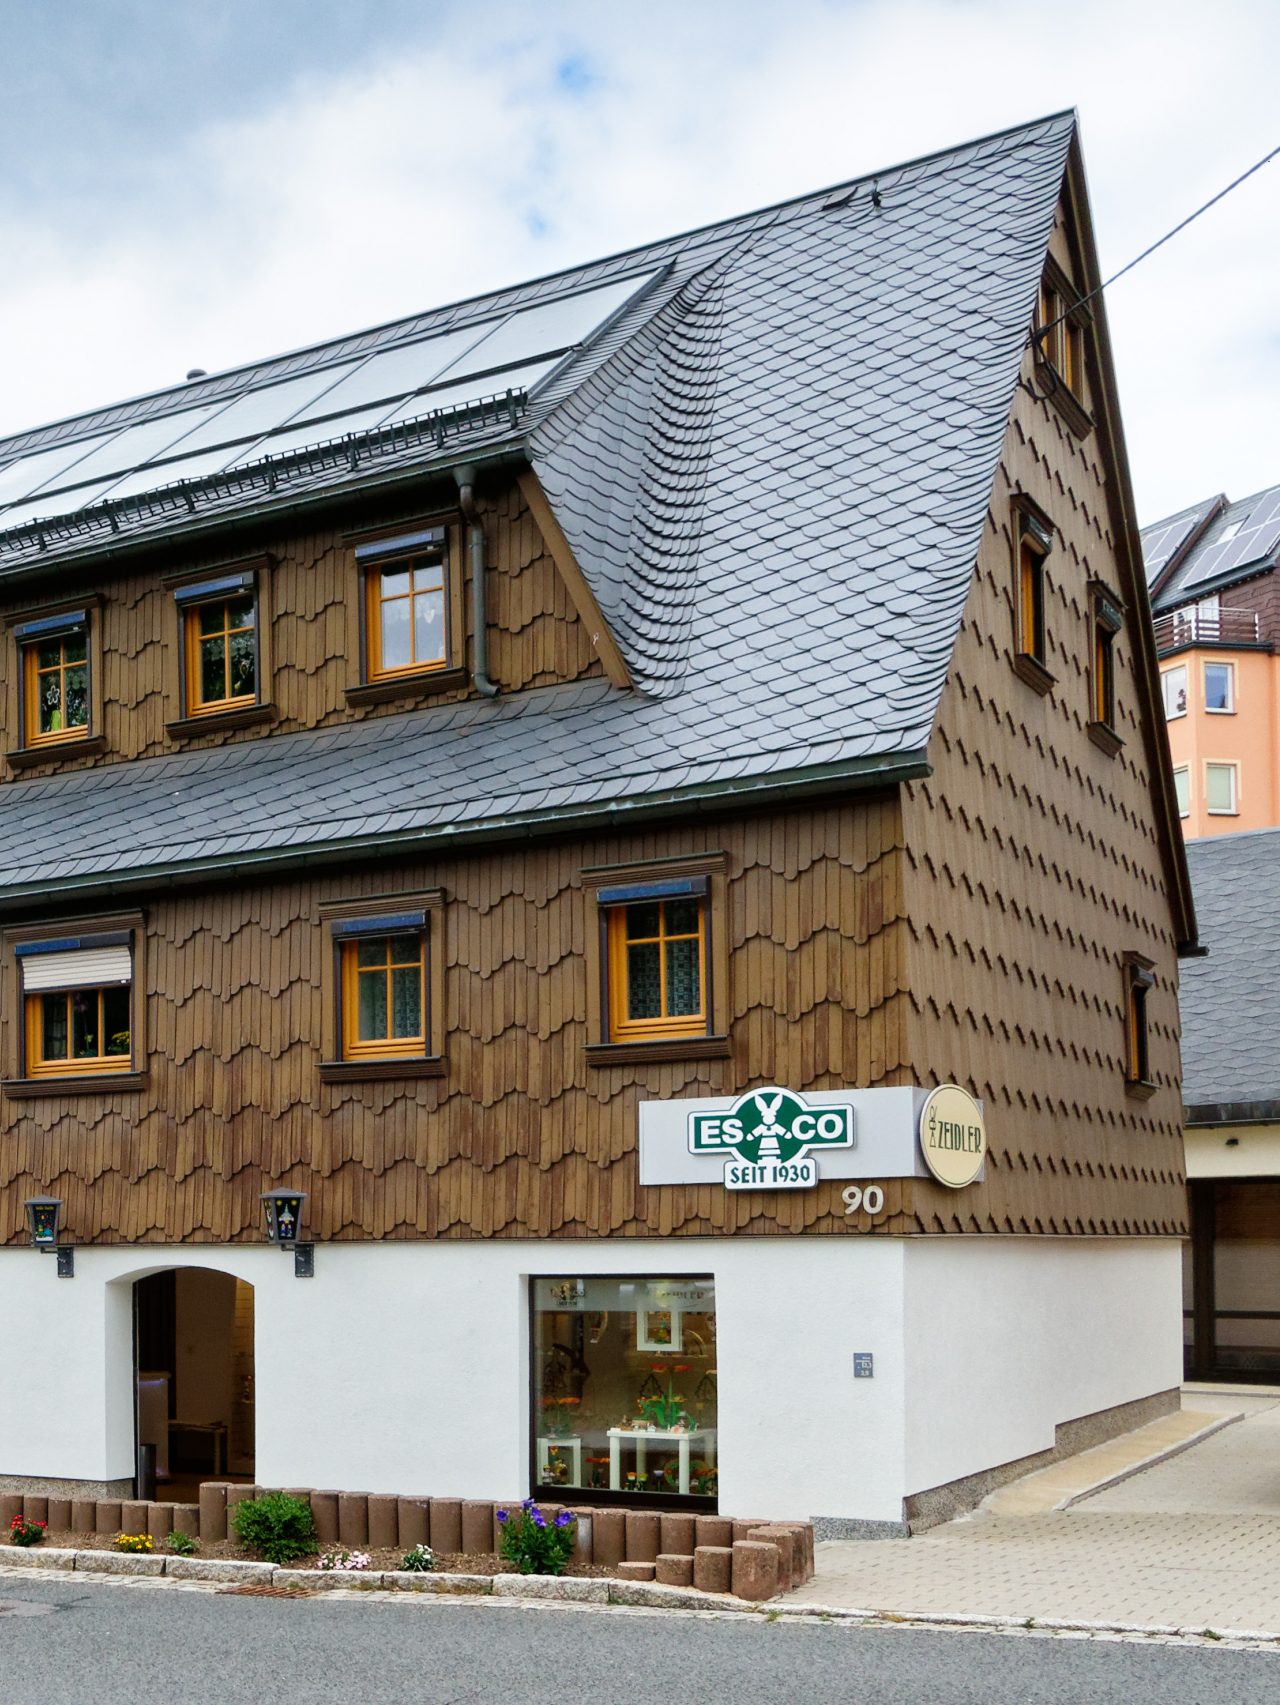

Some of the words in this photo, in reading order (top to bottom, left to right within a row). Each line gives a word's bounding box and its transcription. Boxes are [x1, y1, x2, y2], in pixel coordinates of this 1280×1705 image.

[938, 1120, 982, 1154] ZEIDLER
[730, 1166, 767, 1184] SEIT
[772, 1164, 810, 1183] 1930
[841, 1185, 884, 1215] 90
